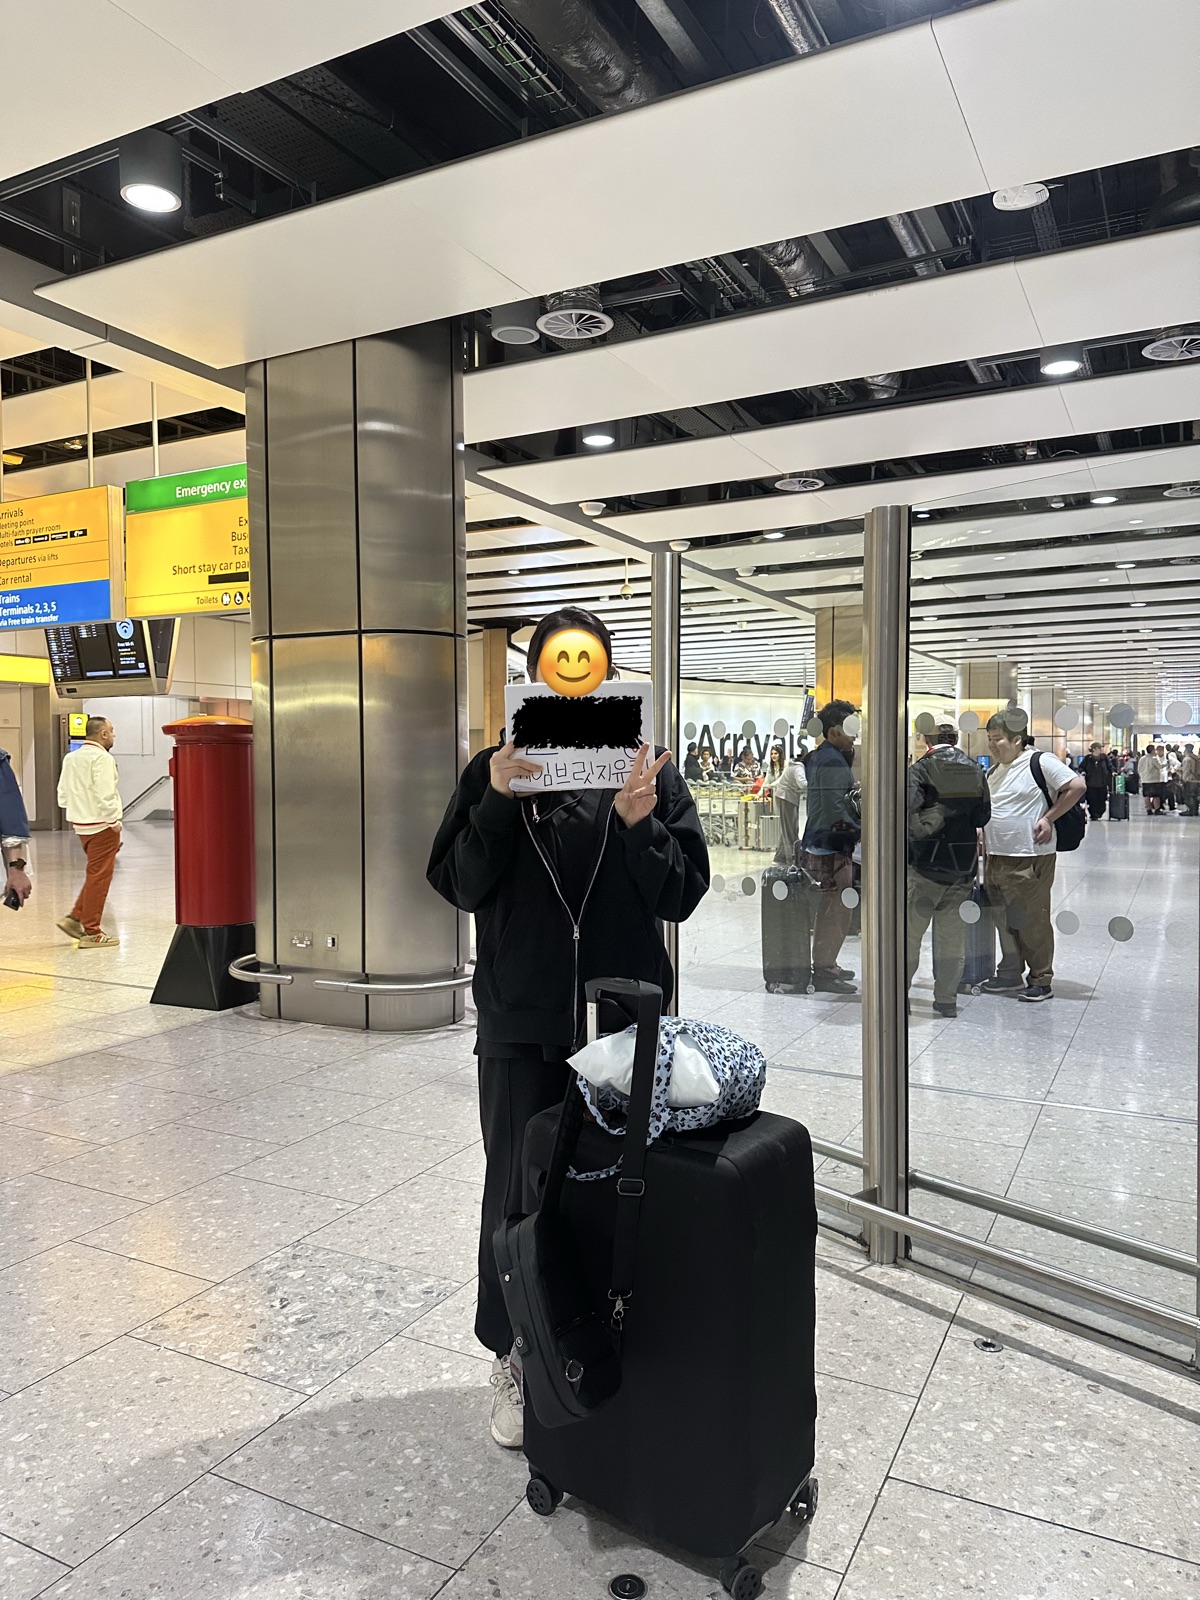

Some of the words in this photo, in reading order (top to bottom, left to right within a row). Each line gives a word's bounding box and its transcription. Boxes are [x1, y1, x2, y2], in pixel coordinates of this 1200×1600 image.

[175, 481, 231, 498] Emergency
[0, 507, 24, 520] rrivals
[20, 518, 34, 528] point
[0, 529, 25, 539] ulti-faith
[26, 526, 45, 536] prayer
[45, 524, 61, 532] room
[231, 531, 248, 542] Bus
[0, 540, 13, 548] otels
[38, 554, 46, 562] via
[47, 552, 59, 561] lifts
[172, 564, 196, 576] Short
[198, 563, 217, 574] stay
[219, 562, 233, 571] car
[10, 573, 32, 585] rental
[51, 601, 57, 611] 5
[196, 596, 219, 605] Toilets
[8, 618, 20, 626] Free
[21, 616, 35, 624] train
[35, 614, 59, 623] transfer
[519, 758, 649, 787] 임브릿지유
